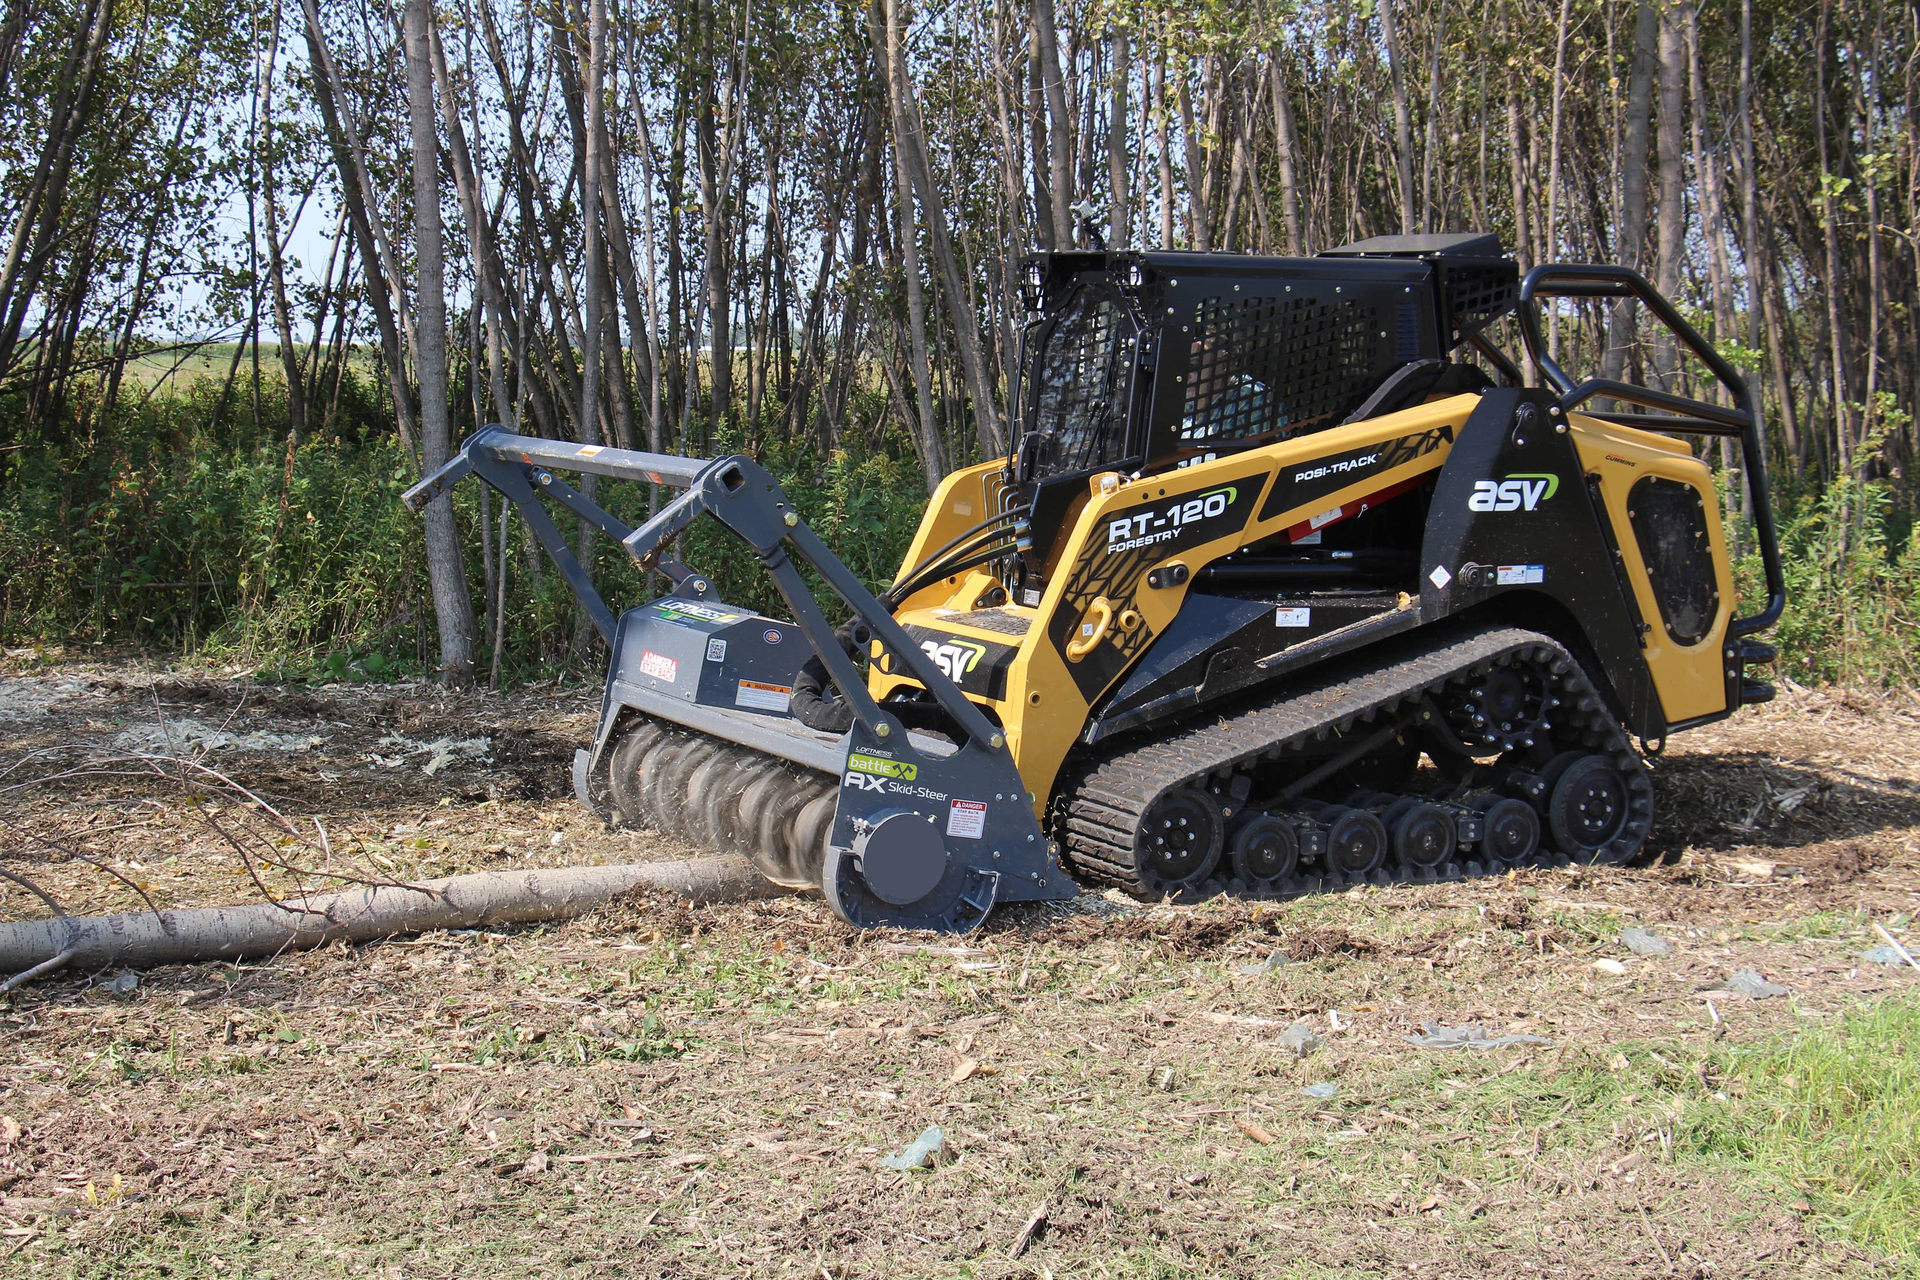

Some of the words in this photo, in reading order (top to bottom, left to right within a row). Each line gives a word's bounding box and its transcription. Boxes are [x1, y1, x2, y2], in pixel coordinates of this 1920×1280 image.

[1295, 453, 1377, 483] POSI-TRACK
[1468, 480, 1547, 511] asv
[1108, 494, 1226, 543] RT-120
[1107, 527, 1182, 555] FORESTRY
[659, 599, 726, 620] LOFTNESS
[641, 661, 658, 675] STAY
[658, 667, 675, 681] BACK
[855, 745, 893, 758] LOFTNESS
[850, 756, 891, 774] battle
[844, 771, 889, 794] AX
[888, 781, 949, 801] Skid-Steer
[961, 802, 983, 810] DANGER
